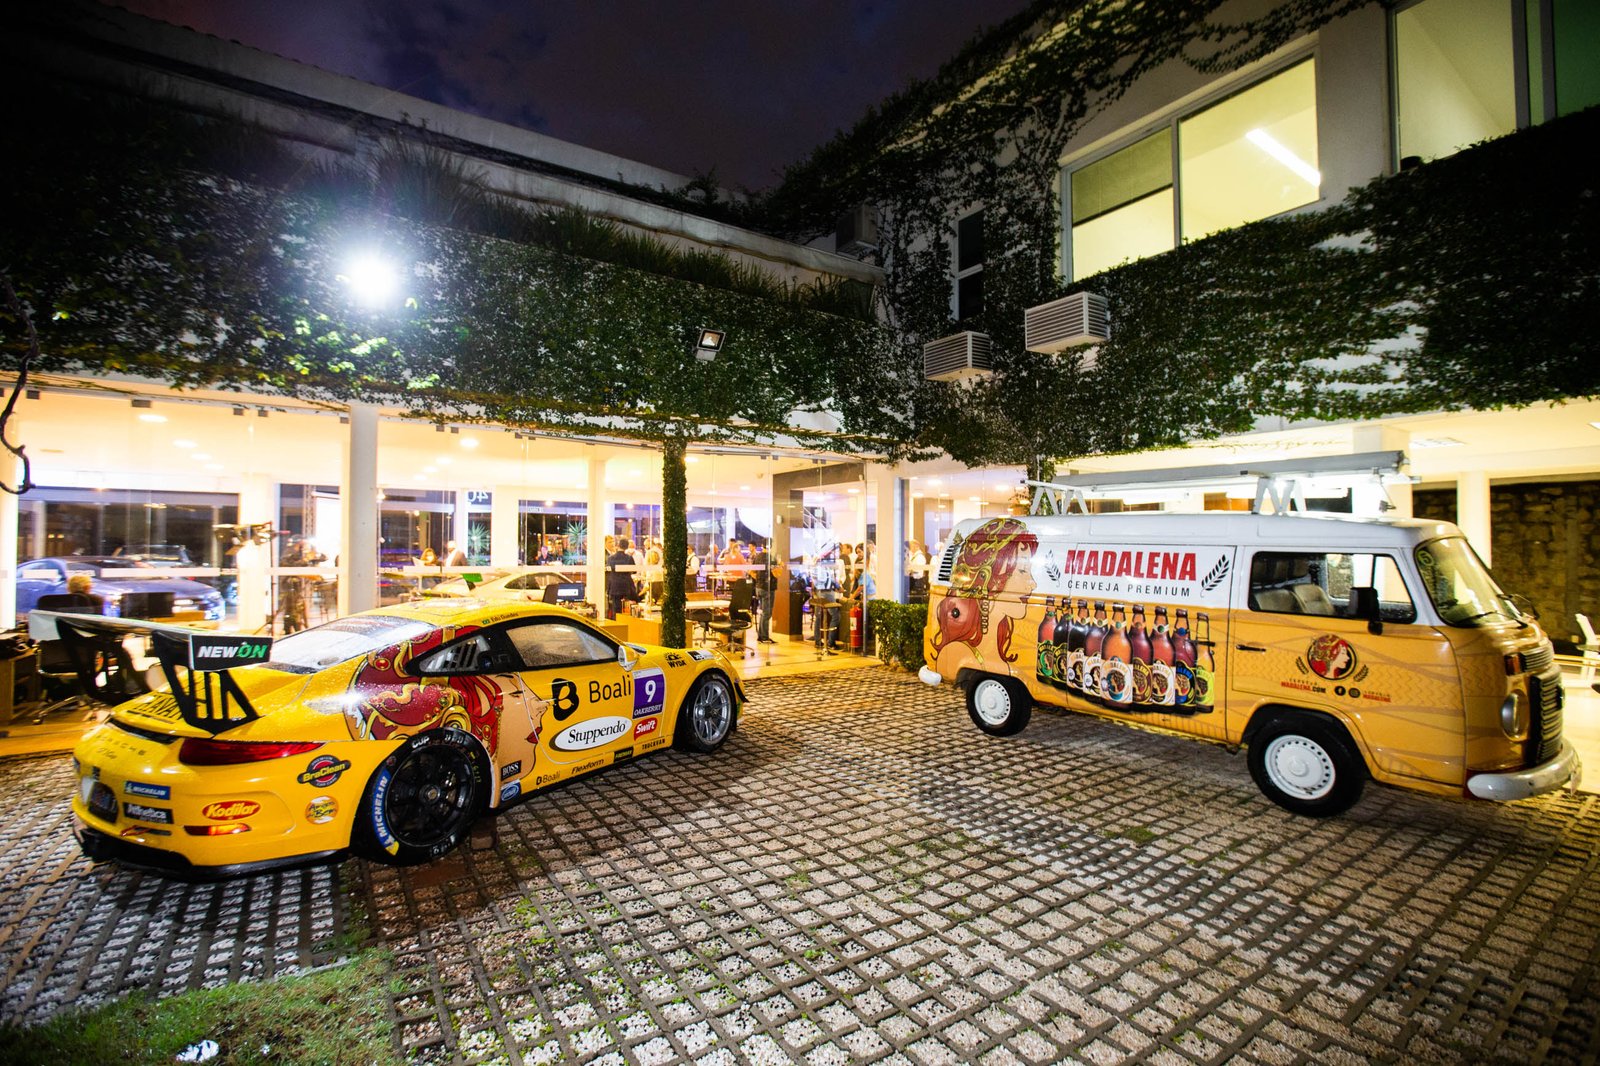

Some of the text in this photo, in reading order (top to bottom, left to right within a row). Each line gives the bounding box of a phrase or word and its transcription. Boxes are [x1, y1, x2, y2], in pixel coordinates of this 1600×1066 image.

[1064, 549, 1197, 581] MADALENA
[1067, 579, 1190, 597] CERVEJA PREMIUM
[588, 675, 632, 704] Boali
[645, 680, 657, 703] 9
[634, 704, 663, 716] OAKBERRY
[568, 720, 626, 745] Stuppendo
[636, 720, 656, 734] Swift
[411, 735, 430, 748] CUP
[642, 739, 666, 750] TRUCKVAN
[302, 762, 346, 782] BraClean
[502, 761, 519, 774] BOSS
[571, 758, 605, 775] Flexform
[543, 771, 560, 783] Boali
[206, 803, 259, 817] Kodilar
[374, 776, 388, 838] MICHELIN
